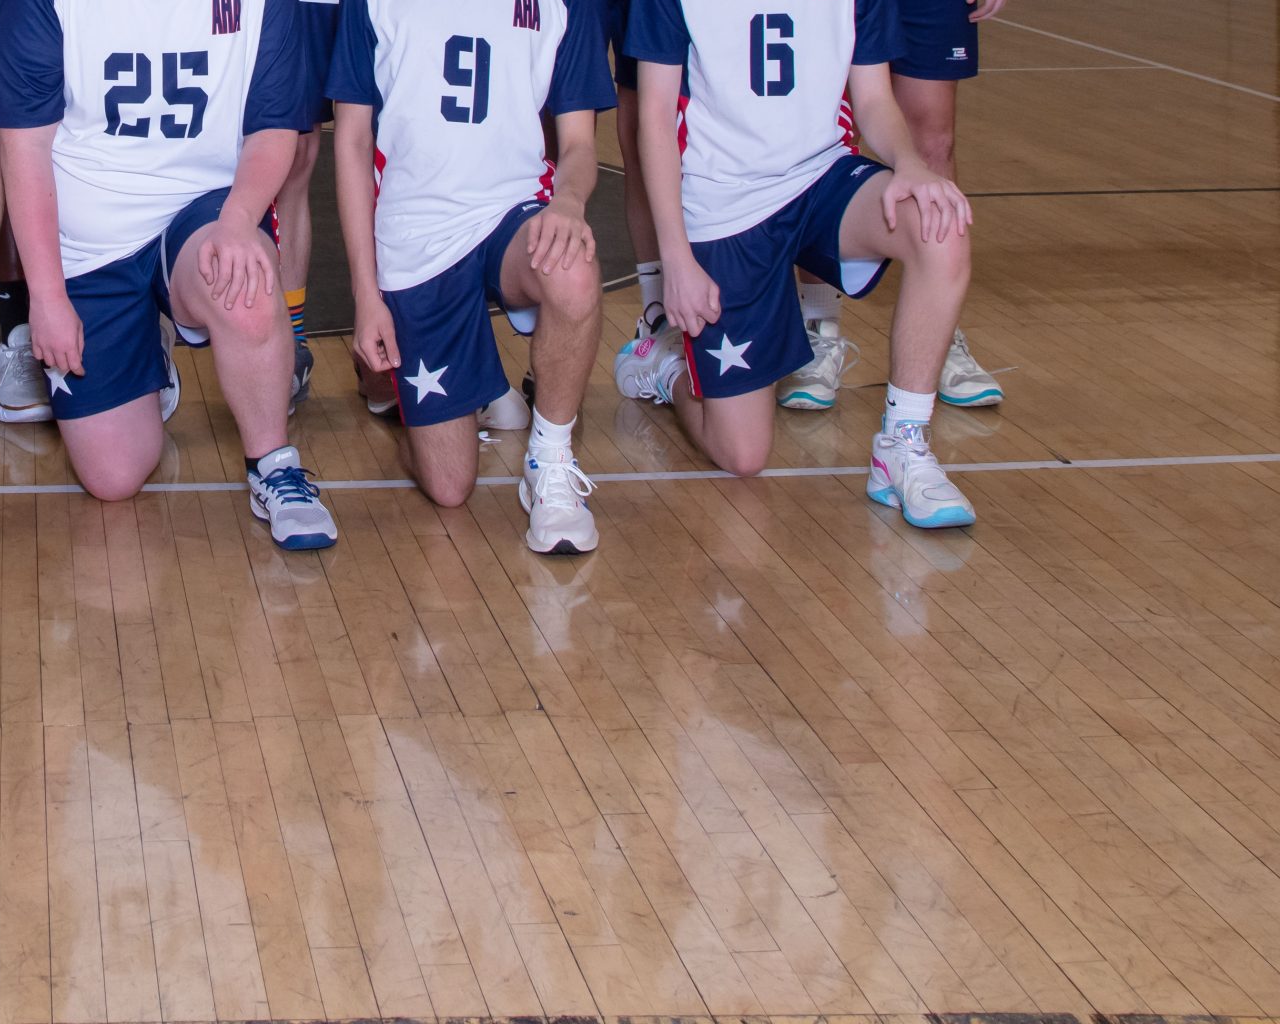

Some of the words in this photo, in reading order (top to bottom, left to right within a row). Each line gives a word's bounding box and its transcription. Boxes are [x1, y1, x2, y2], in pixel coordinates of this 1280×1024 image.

[104, 51, 208, 138] 25
[441, 35, 490, 124] 9
[750, 14, 794, 96] 6
